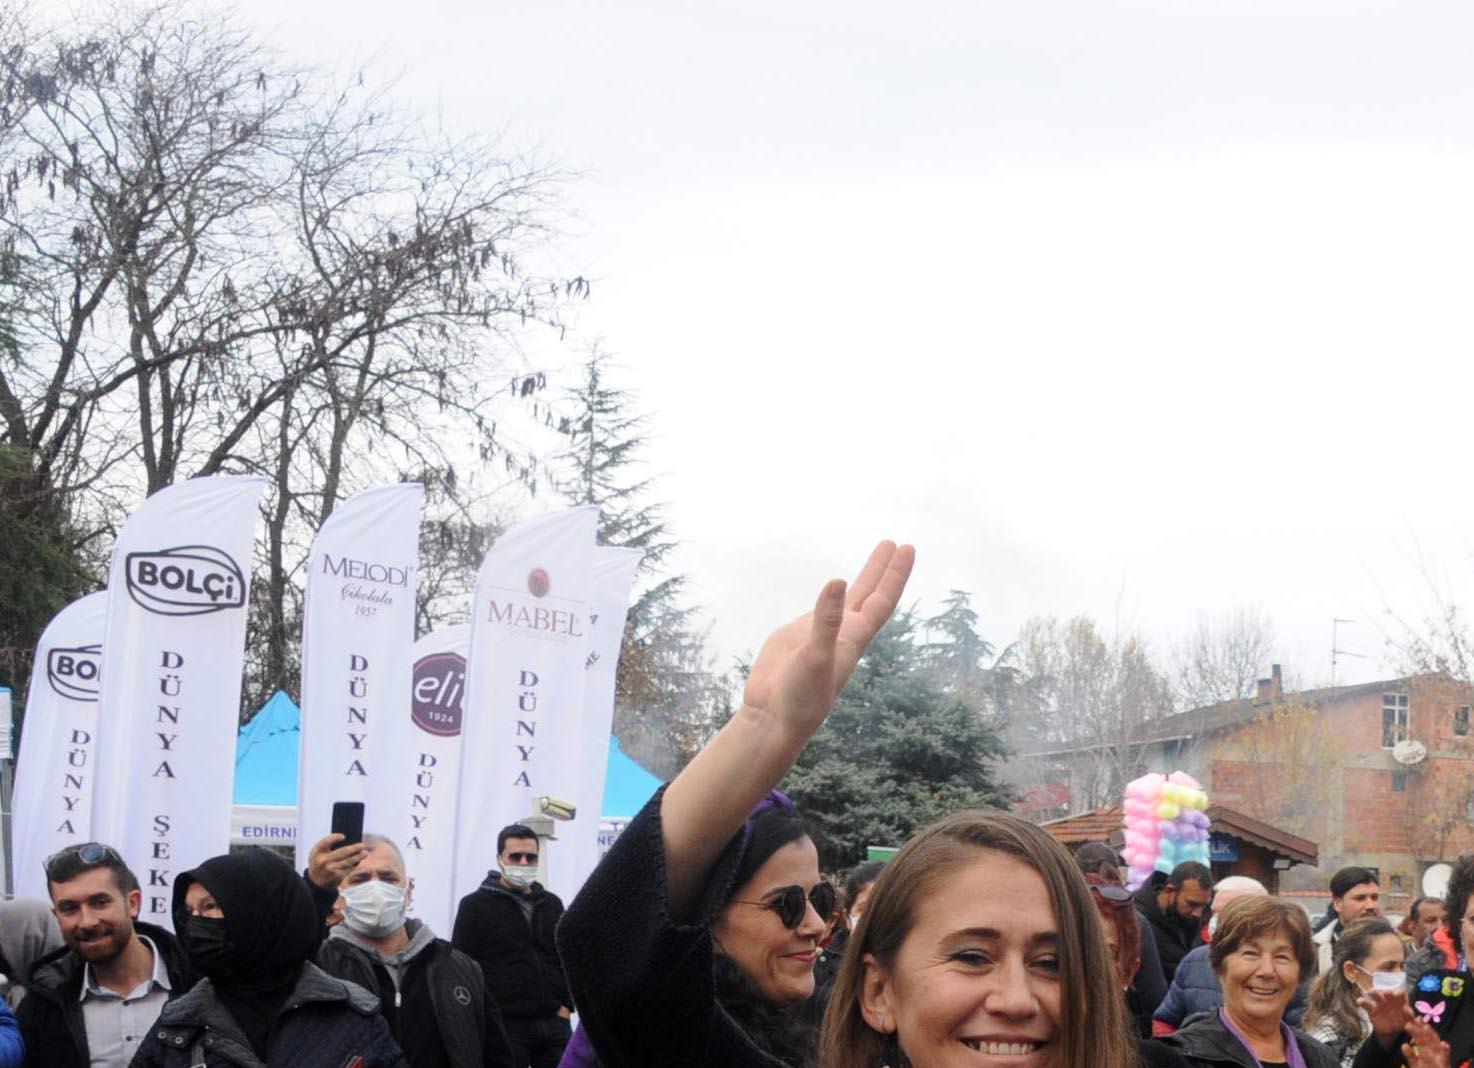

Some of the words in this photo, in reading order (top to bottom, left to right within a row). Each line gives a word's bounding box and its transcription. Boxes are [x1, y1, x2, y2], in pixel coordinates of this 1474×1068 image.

[57, 655, 101, 681] BO
[488, 599, 584, 637] MABEL
[152, 650, 184, 779] DÜNYA
[346, 653, 369, 776] DÜNYA
[414, 670, 466, 707] eli
[513, 669, 539, 787] DÜNYA
[57, 729, 91, 834] DÜNYA
[407, 753, 437, 850] DÜNYA
